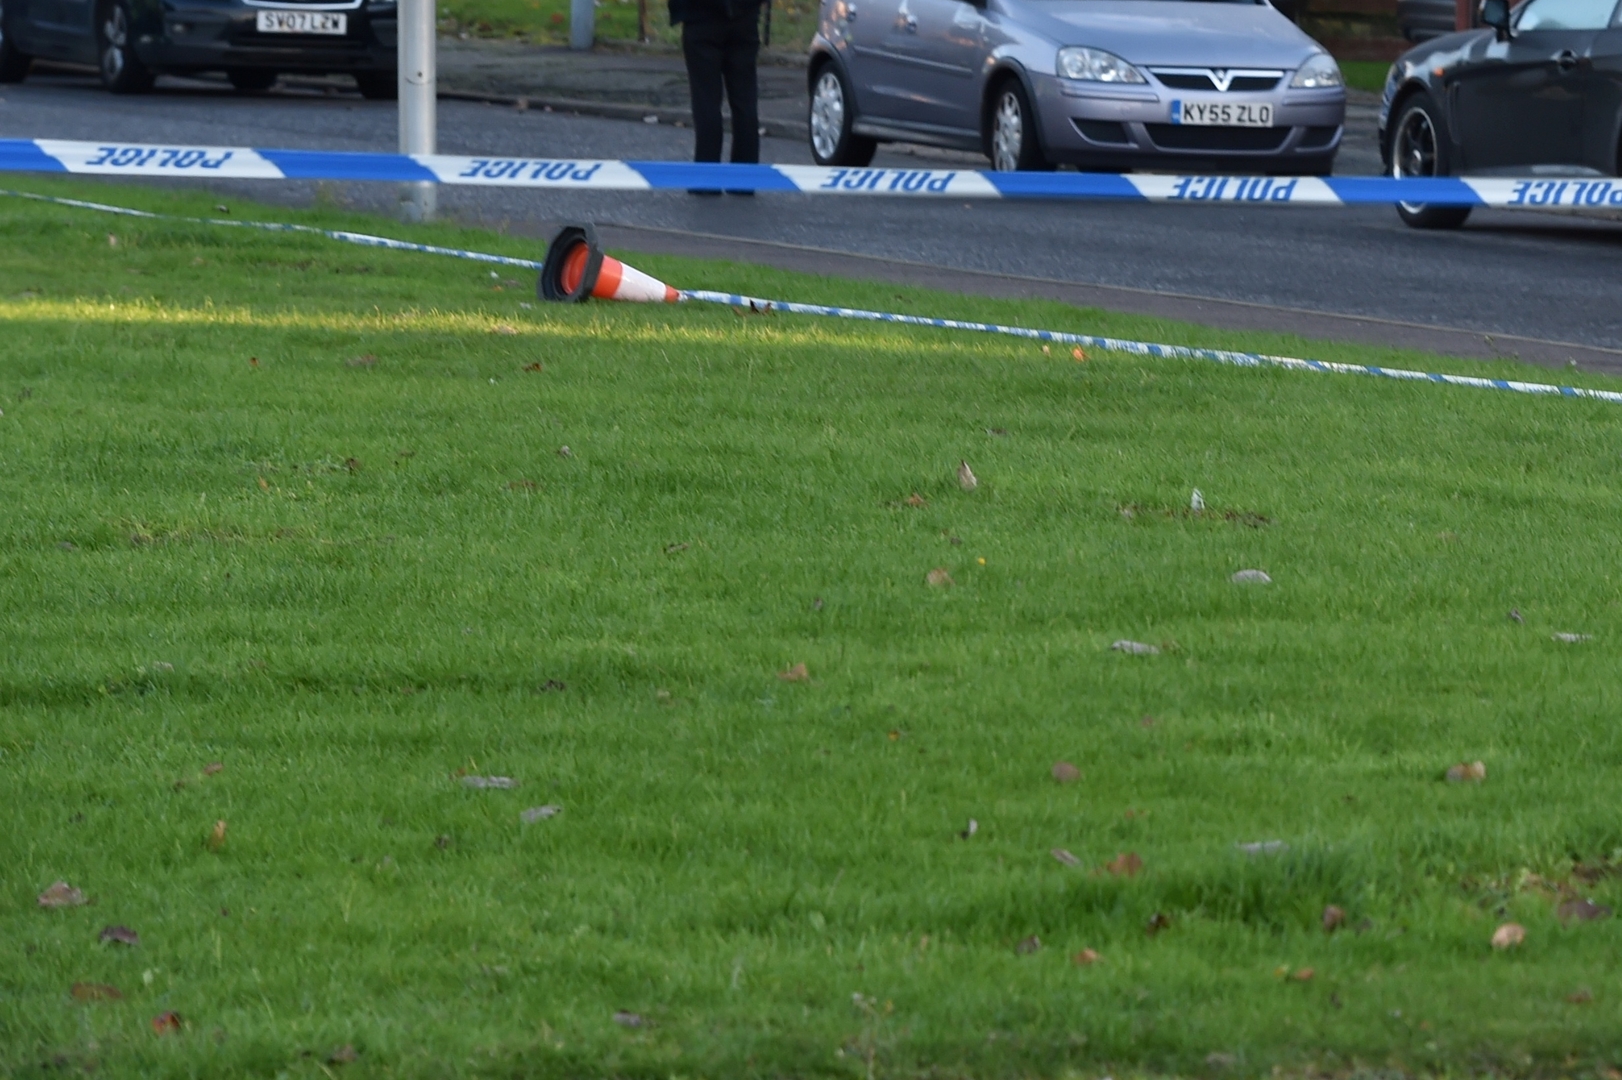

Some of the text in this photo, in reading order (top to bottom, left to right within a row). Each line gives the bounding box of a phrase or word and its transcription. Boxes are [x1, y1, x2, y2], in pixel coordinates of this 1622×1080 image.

[1183, 104, 1231, 122] KY55
[85, 146, 233, 169] POLICE
[460, 159, 603, 181] POLICE
[820, 168, 955, 193] POLICE
[1167, 176, 1300, 202] POLICE
